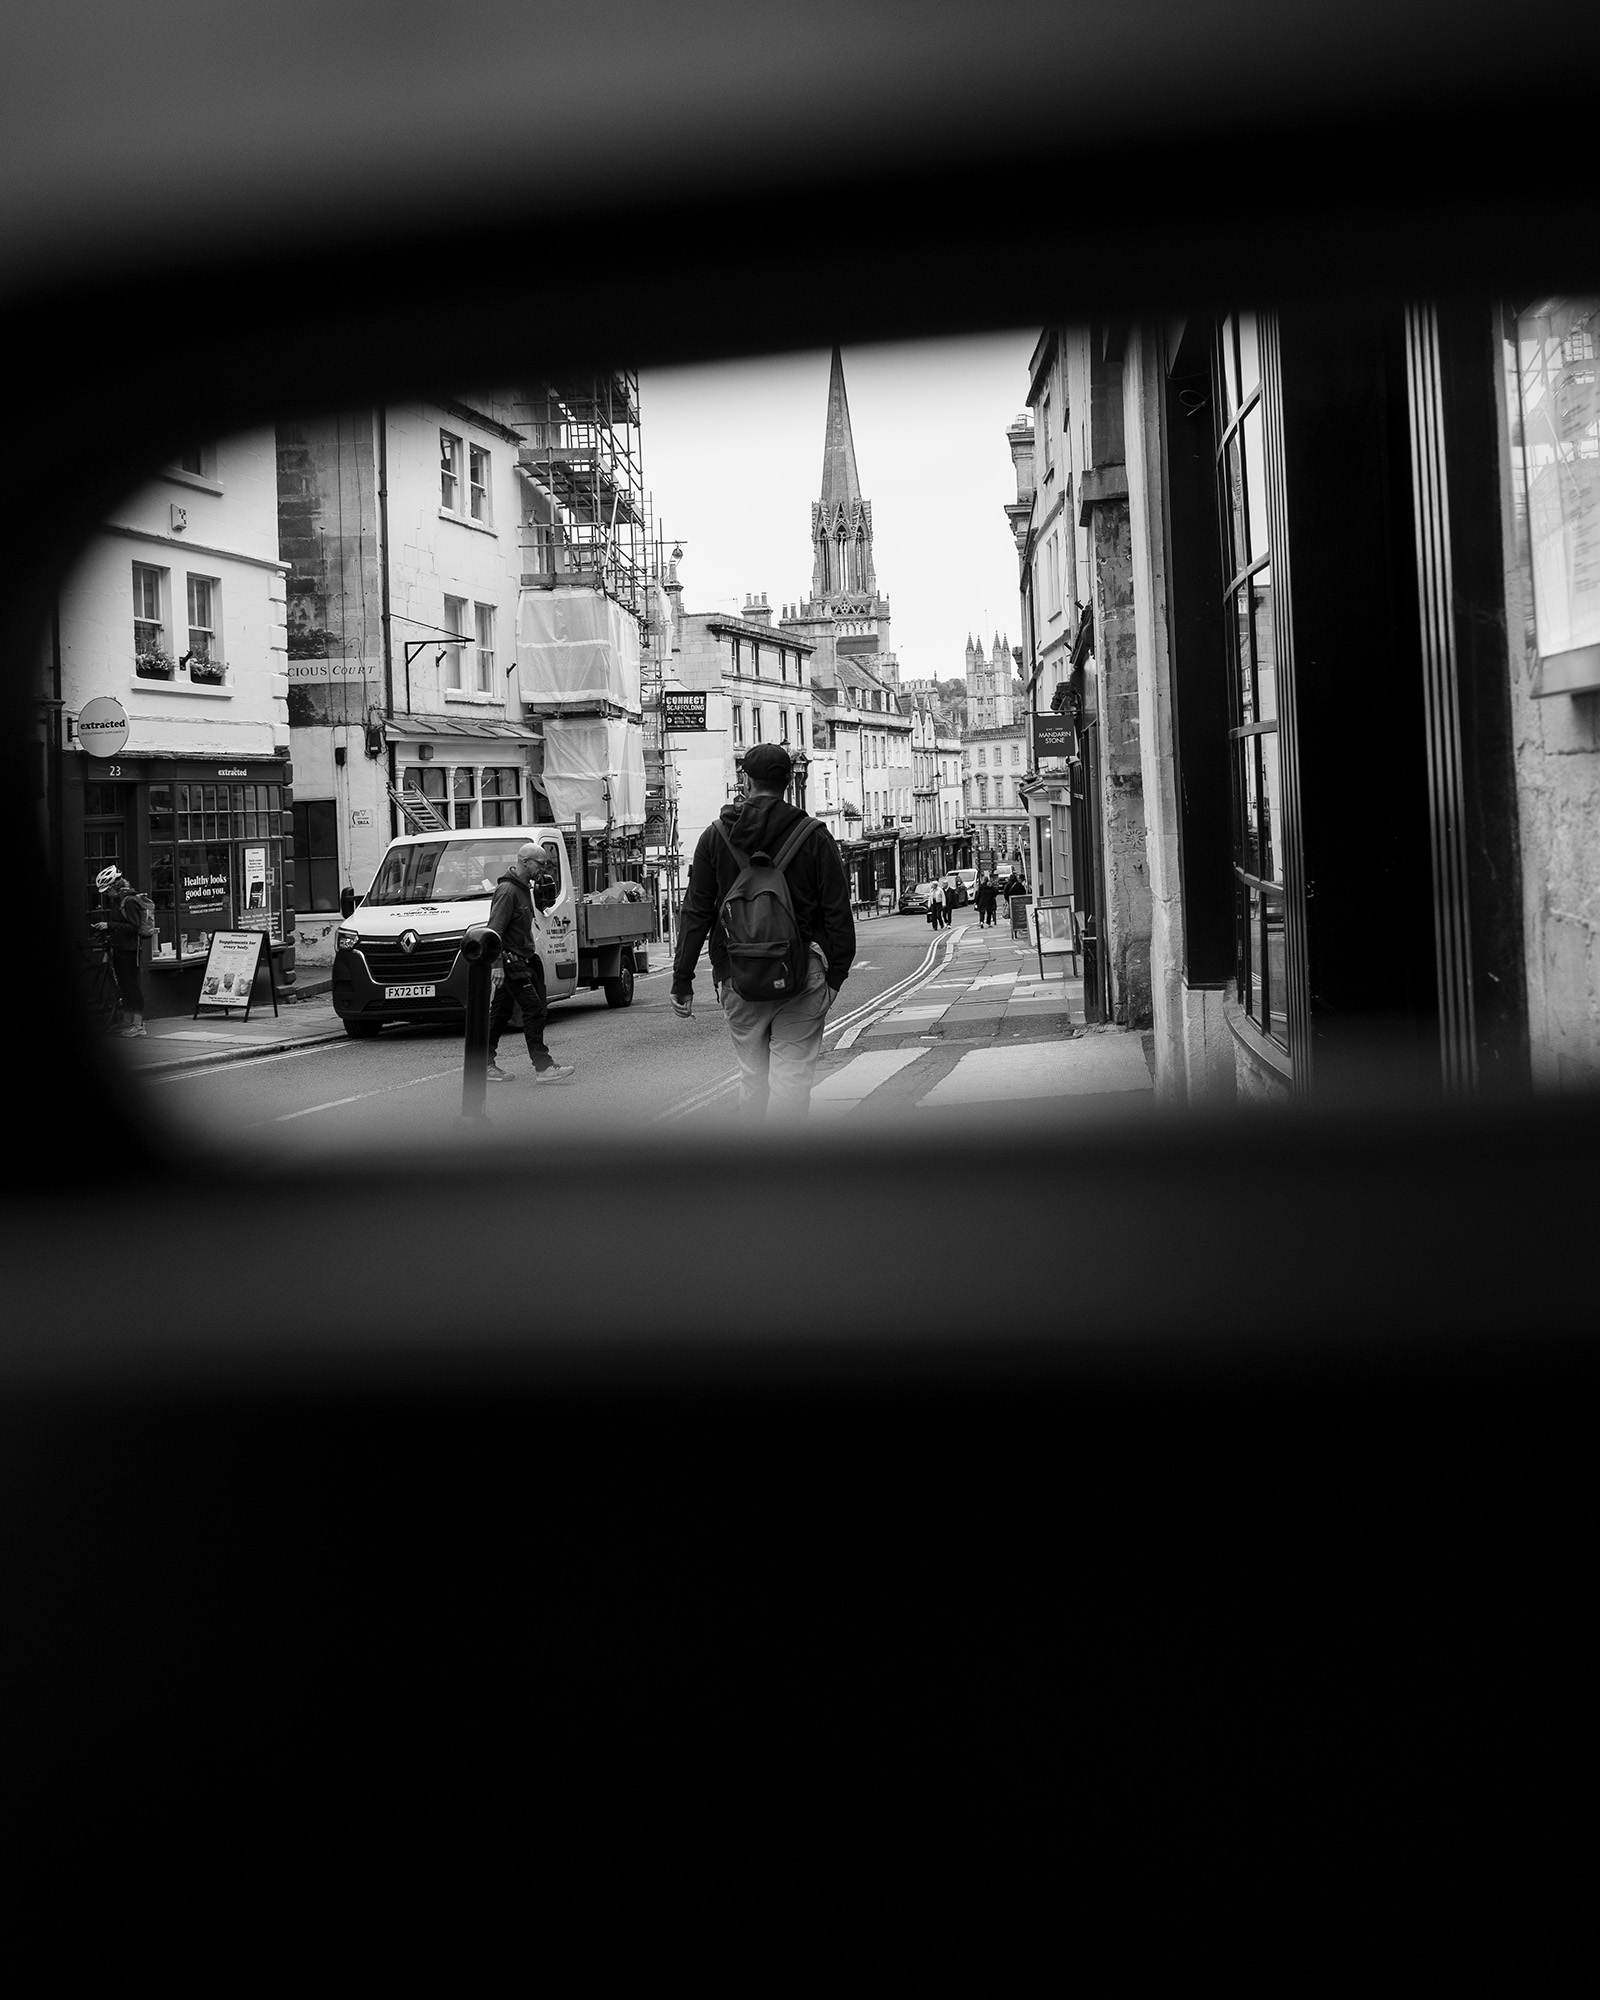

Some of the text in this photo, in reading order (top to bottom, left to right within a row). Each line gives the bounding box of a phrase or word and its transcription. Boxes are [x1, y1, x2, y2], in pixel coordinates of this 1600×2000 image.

[332, 665, 376, 676] COURT
[666, 696, 705, 705] CONNECT
[80, 719, 126, 730] extracted
[109, 765, 121, 776] 23
[217, 768, 247, 776] extracted
[184, 874, 227, 887] Healthy looks
[185, 887, 226, 901] good on you.
[388, 986, 431, 997] FX72 CTF
